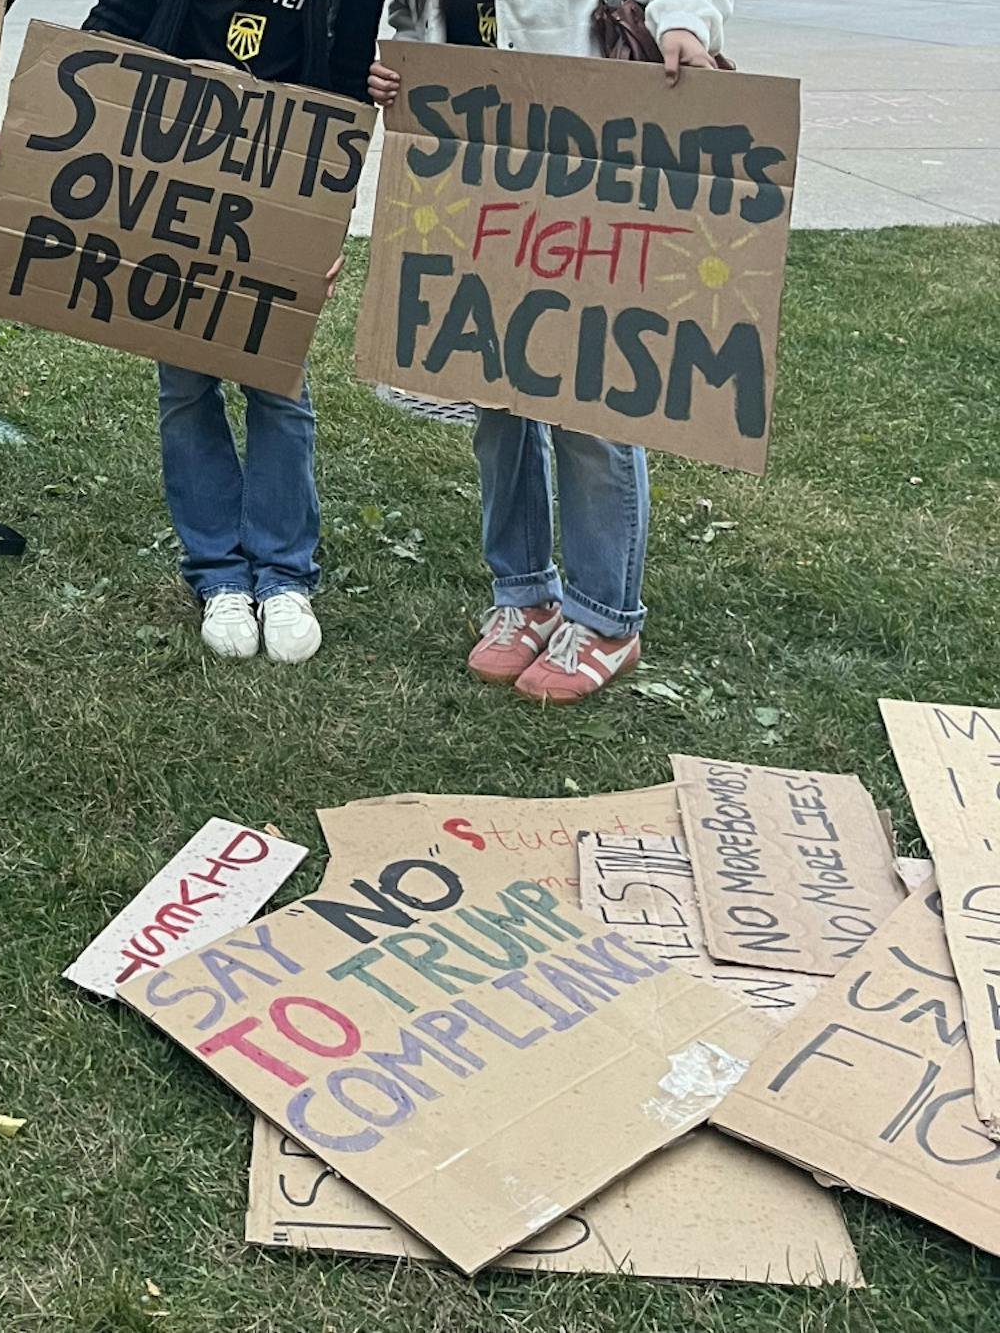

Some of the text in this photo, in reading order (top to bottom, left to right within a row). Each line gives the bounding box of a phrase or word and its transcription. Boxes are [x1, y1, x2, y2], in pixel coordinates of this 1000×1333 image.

[25, 50, 371, 197] STUDENTS
[406, 84, 787, 223] STUDENTS
[50, 152, 254, 263] OVER
[472, 202, 694, 293] FIGHT
[9, 216, 297, 355] PROFIT
[396, 252, 767, 439] FACISM
[146, 924, 306, 1031] SAY
[195, 879, 587, 1088] TO TRUMP
[724, 905, 801, 953] NO
[286, 931, 674, 1154] COMPLIANCE
